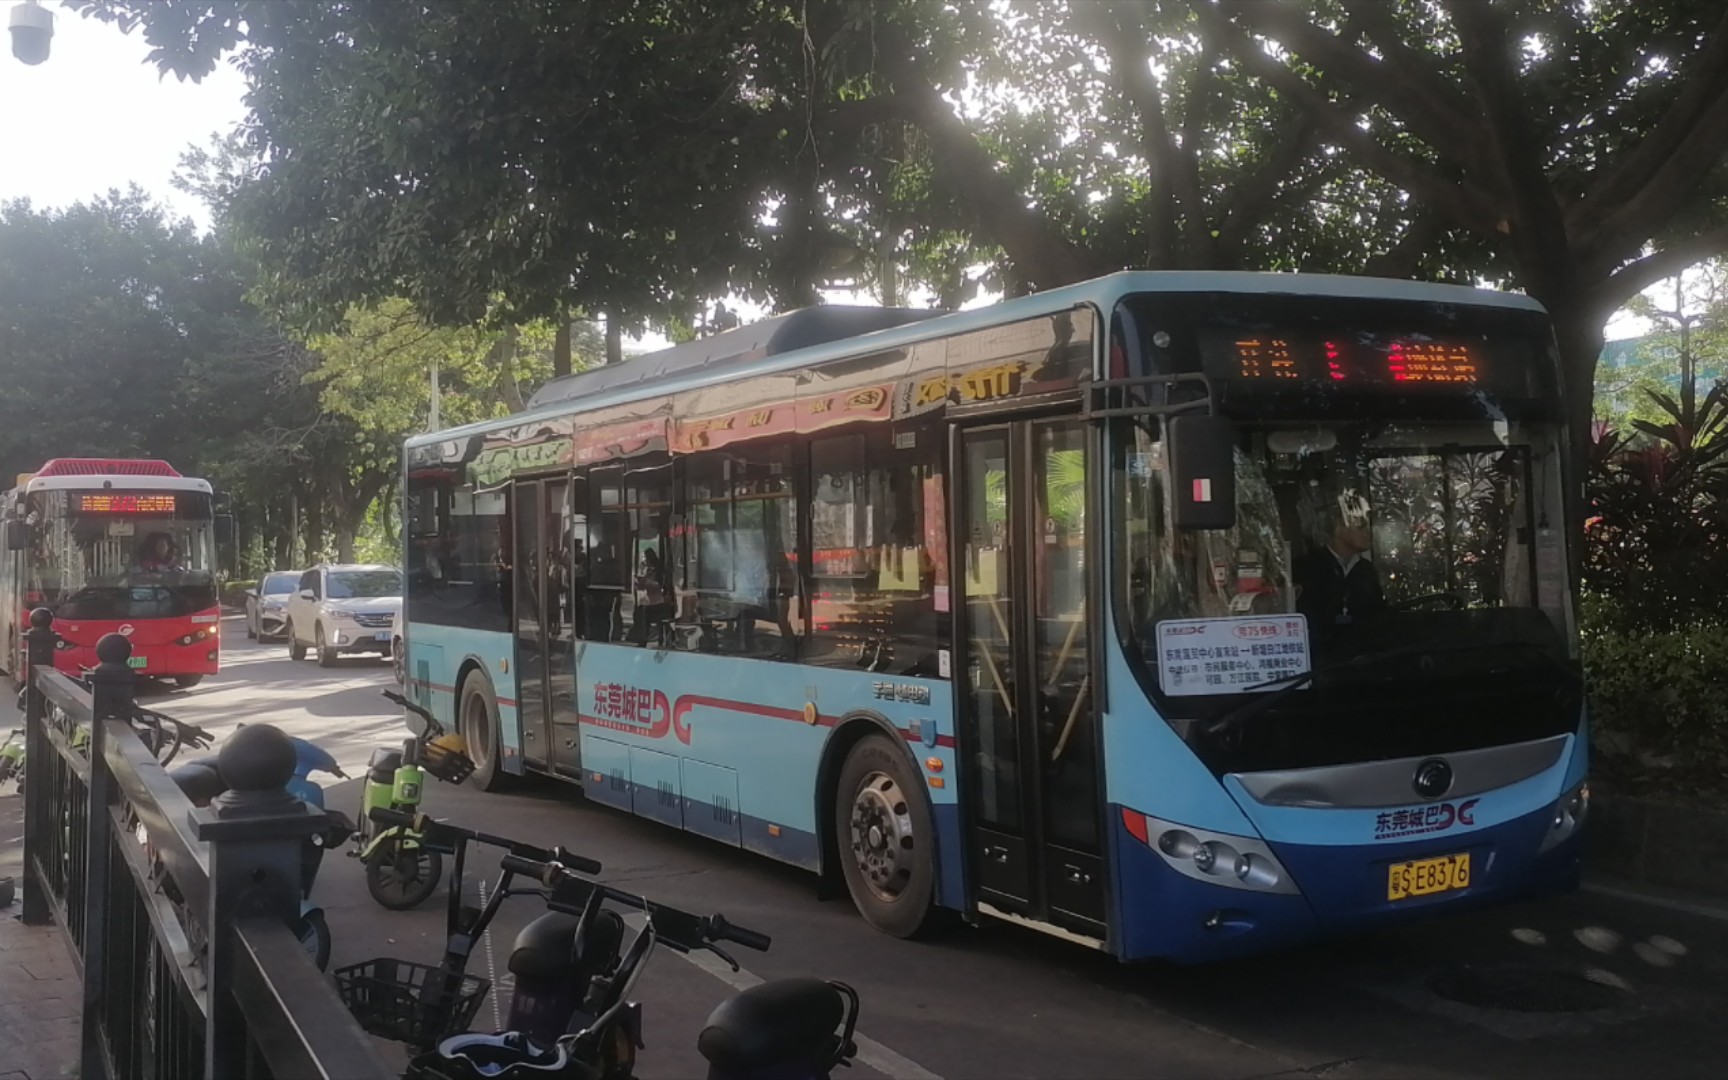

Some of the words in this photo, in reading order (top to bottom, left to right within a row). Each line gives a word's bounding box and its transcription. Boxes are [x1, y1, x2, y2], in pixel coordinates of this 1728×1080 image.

[593, 680, 652, 724] 东莞城巴
[1375, 806, 1440, 833] 东莞城巴
